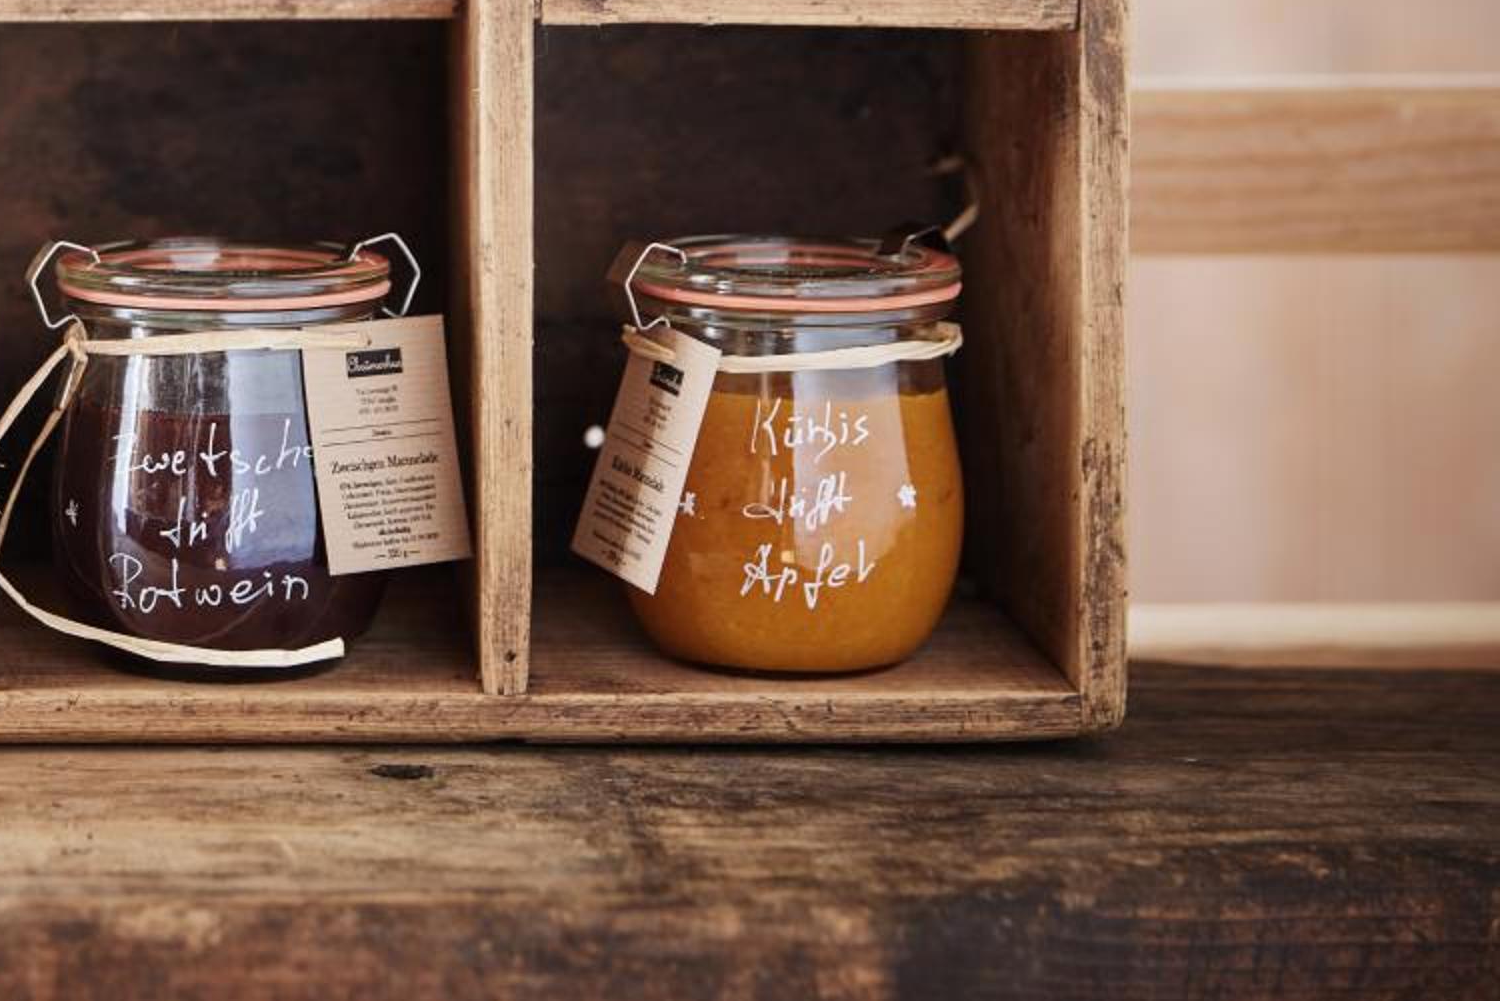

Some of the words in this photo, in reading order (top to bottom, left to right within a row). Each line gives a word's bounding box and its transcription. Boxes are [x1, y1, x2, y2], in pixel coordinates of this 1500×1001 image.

[751, 397, 869, 463] Kürbis
[109, 552, 309, 614] Rotwein
[740, 539, 875, 610] Apfel
